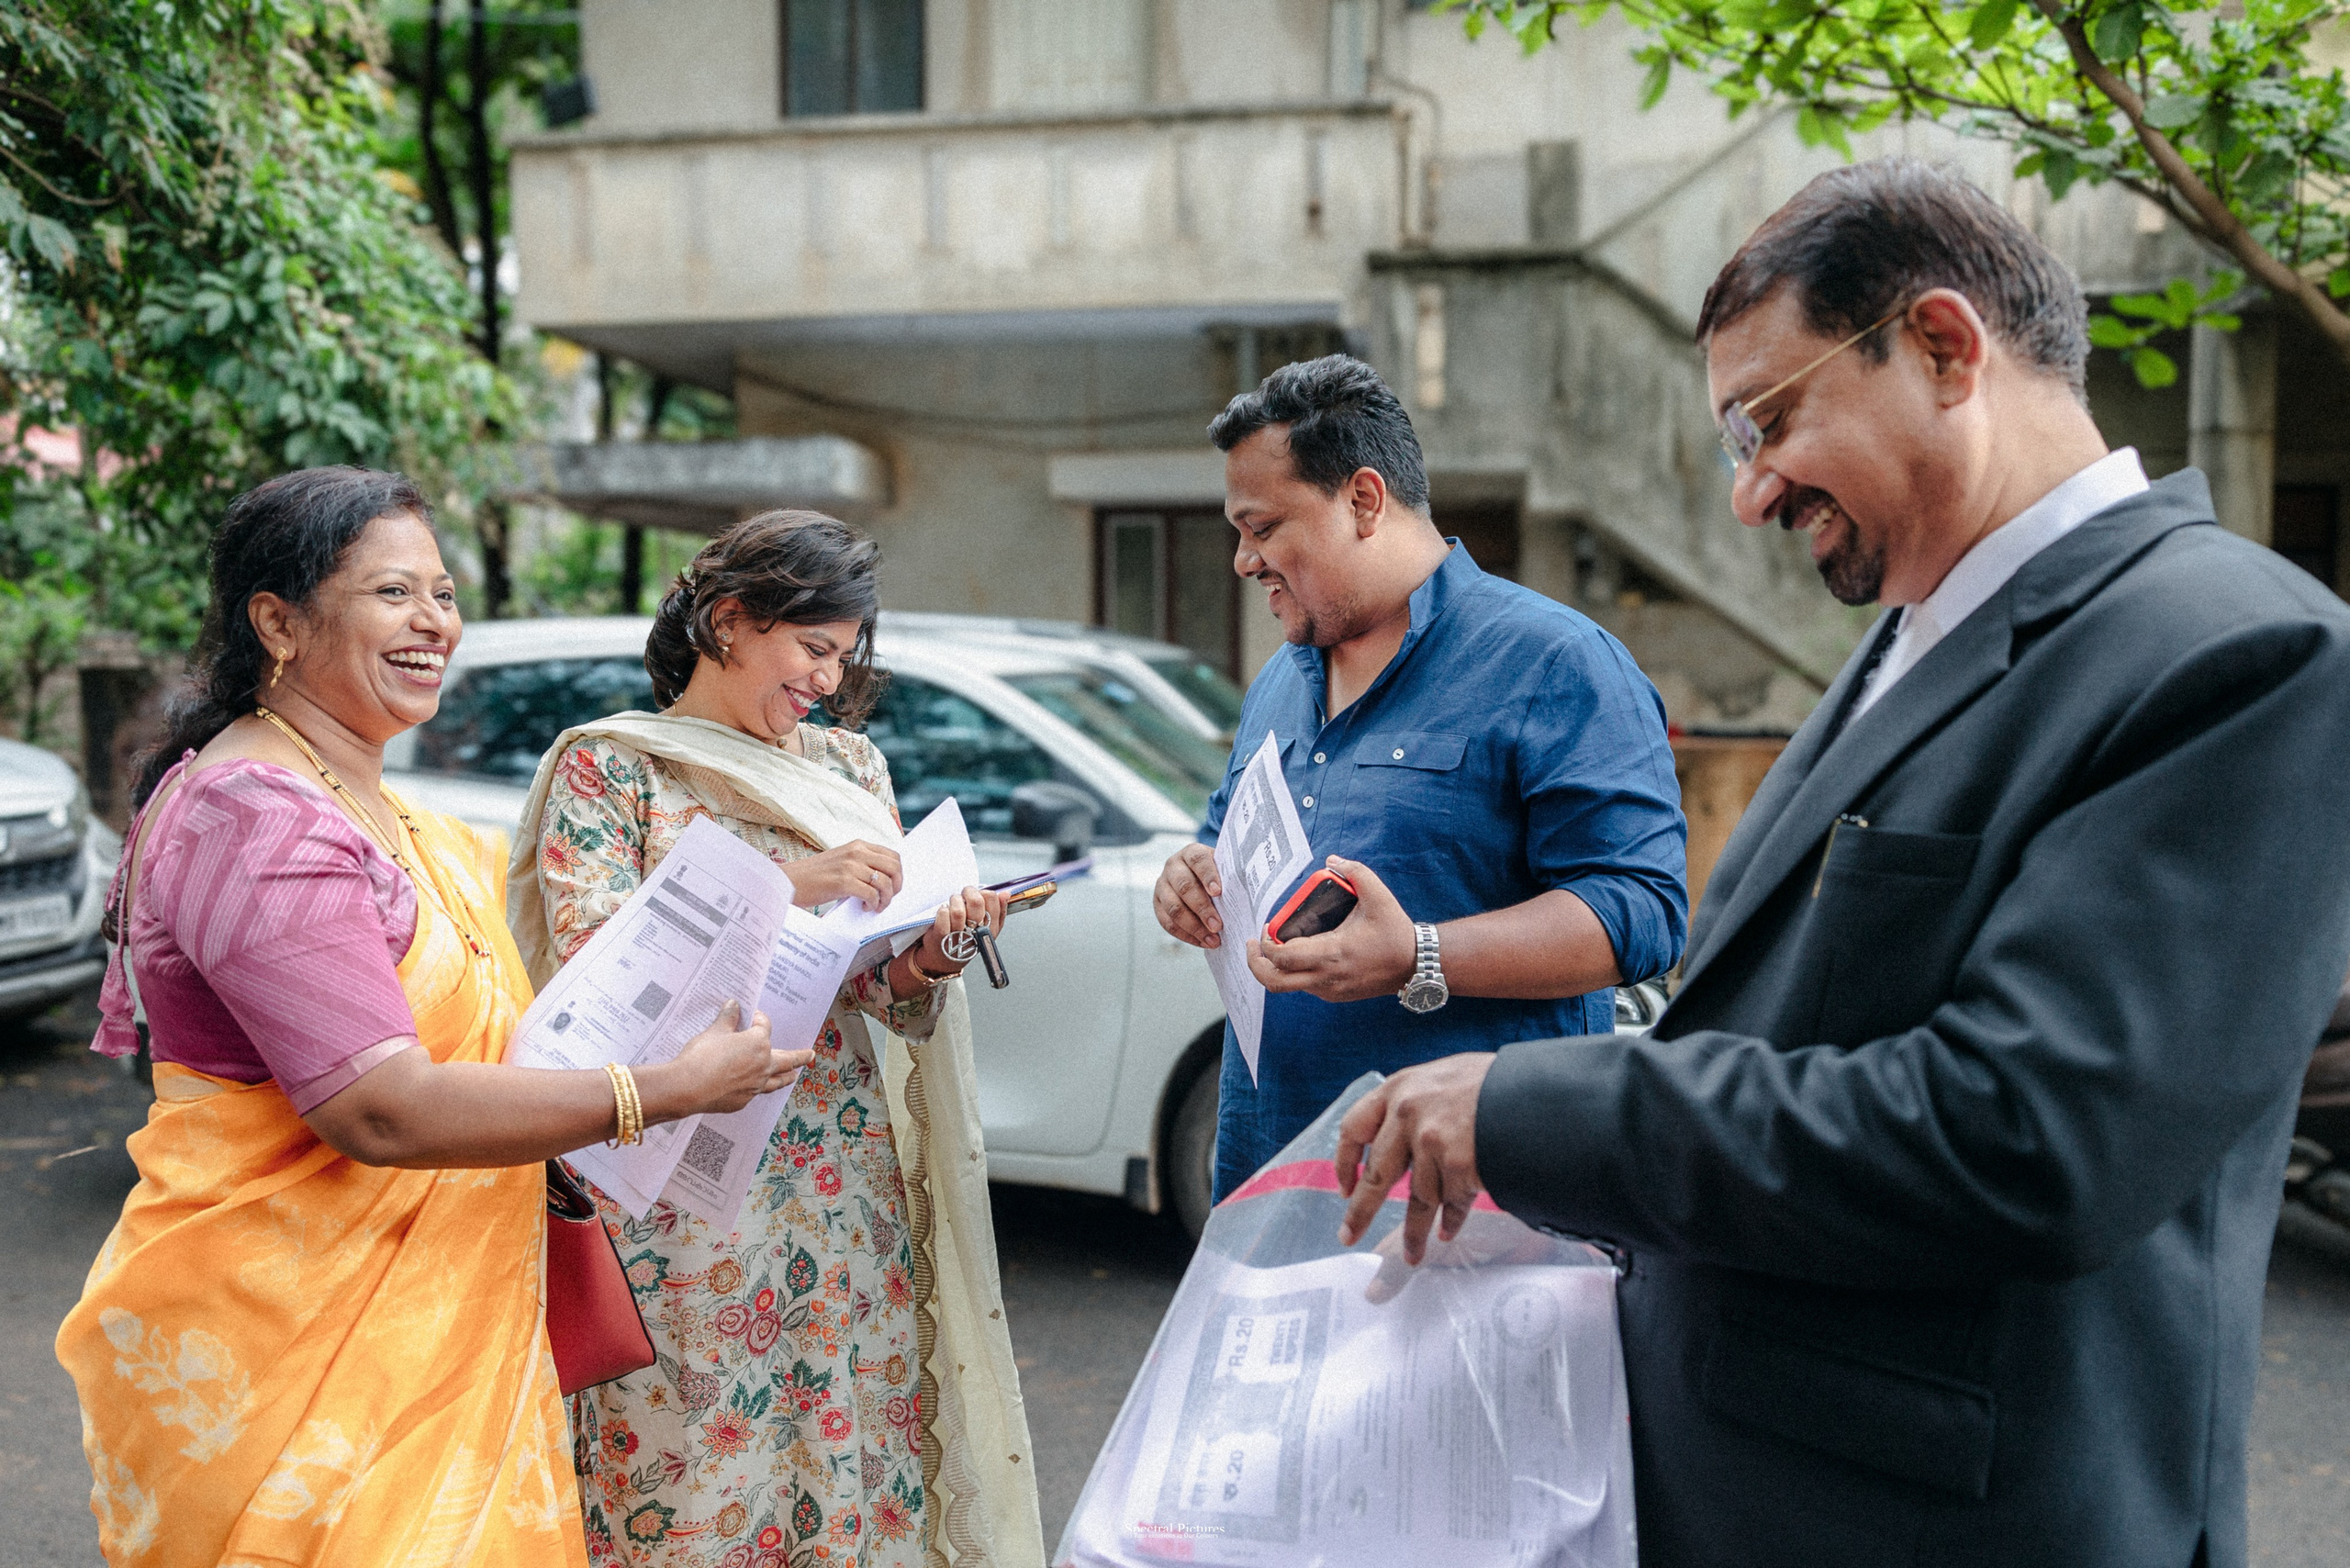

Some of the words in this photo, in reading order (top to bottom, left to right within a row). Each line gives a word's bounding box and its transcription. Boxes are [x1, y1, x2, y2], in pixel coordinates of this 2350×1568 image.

[1264, 840, 1277, 871] Rs.20
[806, 955, 820, 967] India
[1228, 1317, 1254, 1367] Rs.20
[1270, 1320, 1285, 1365] TWENTY
